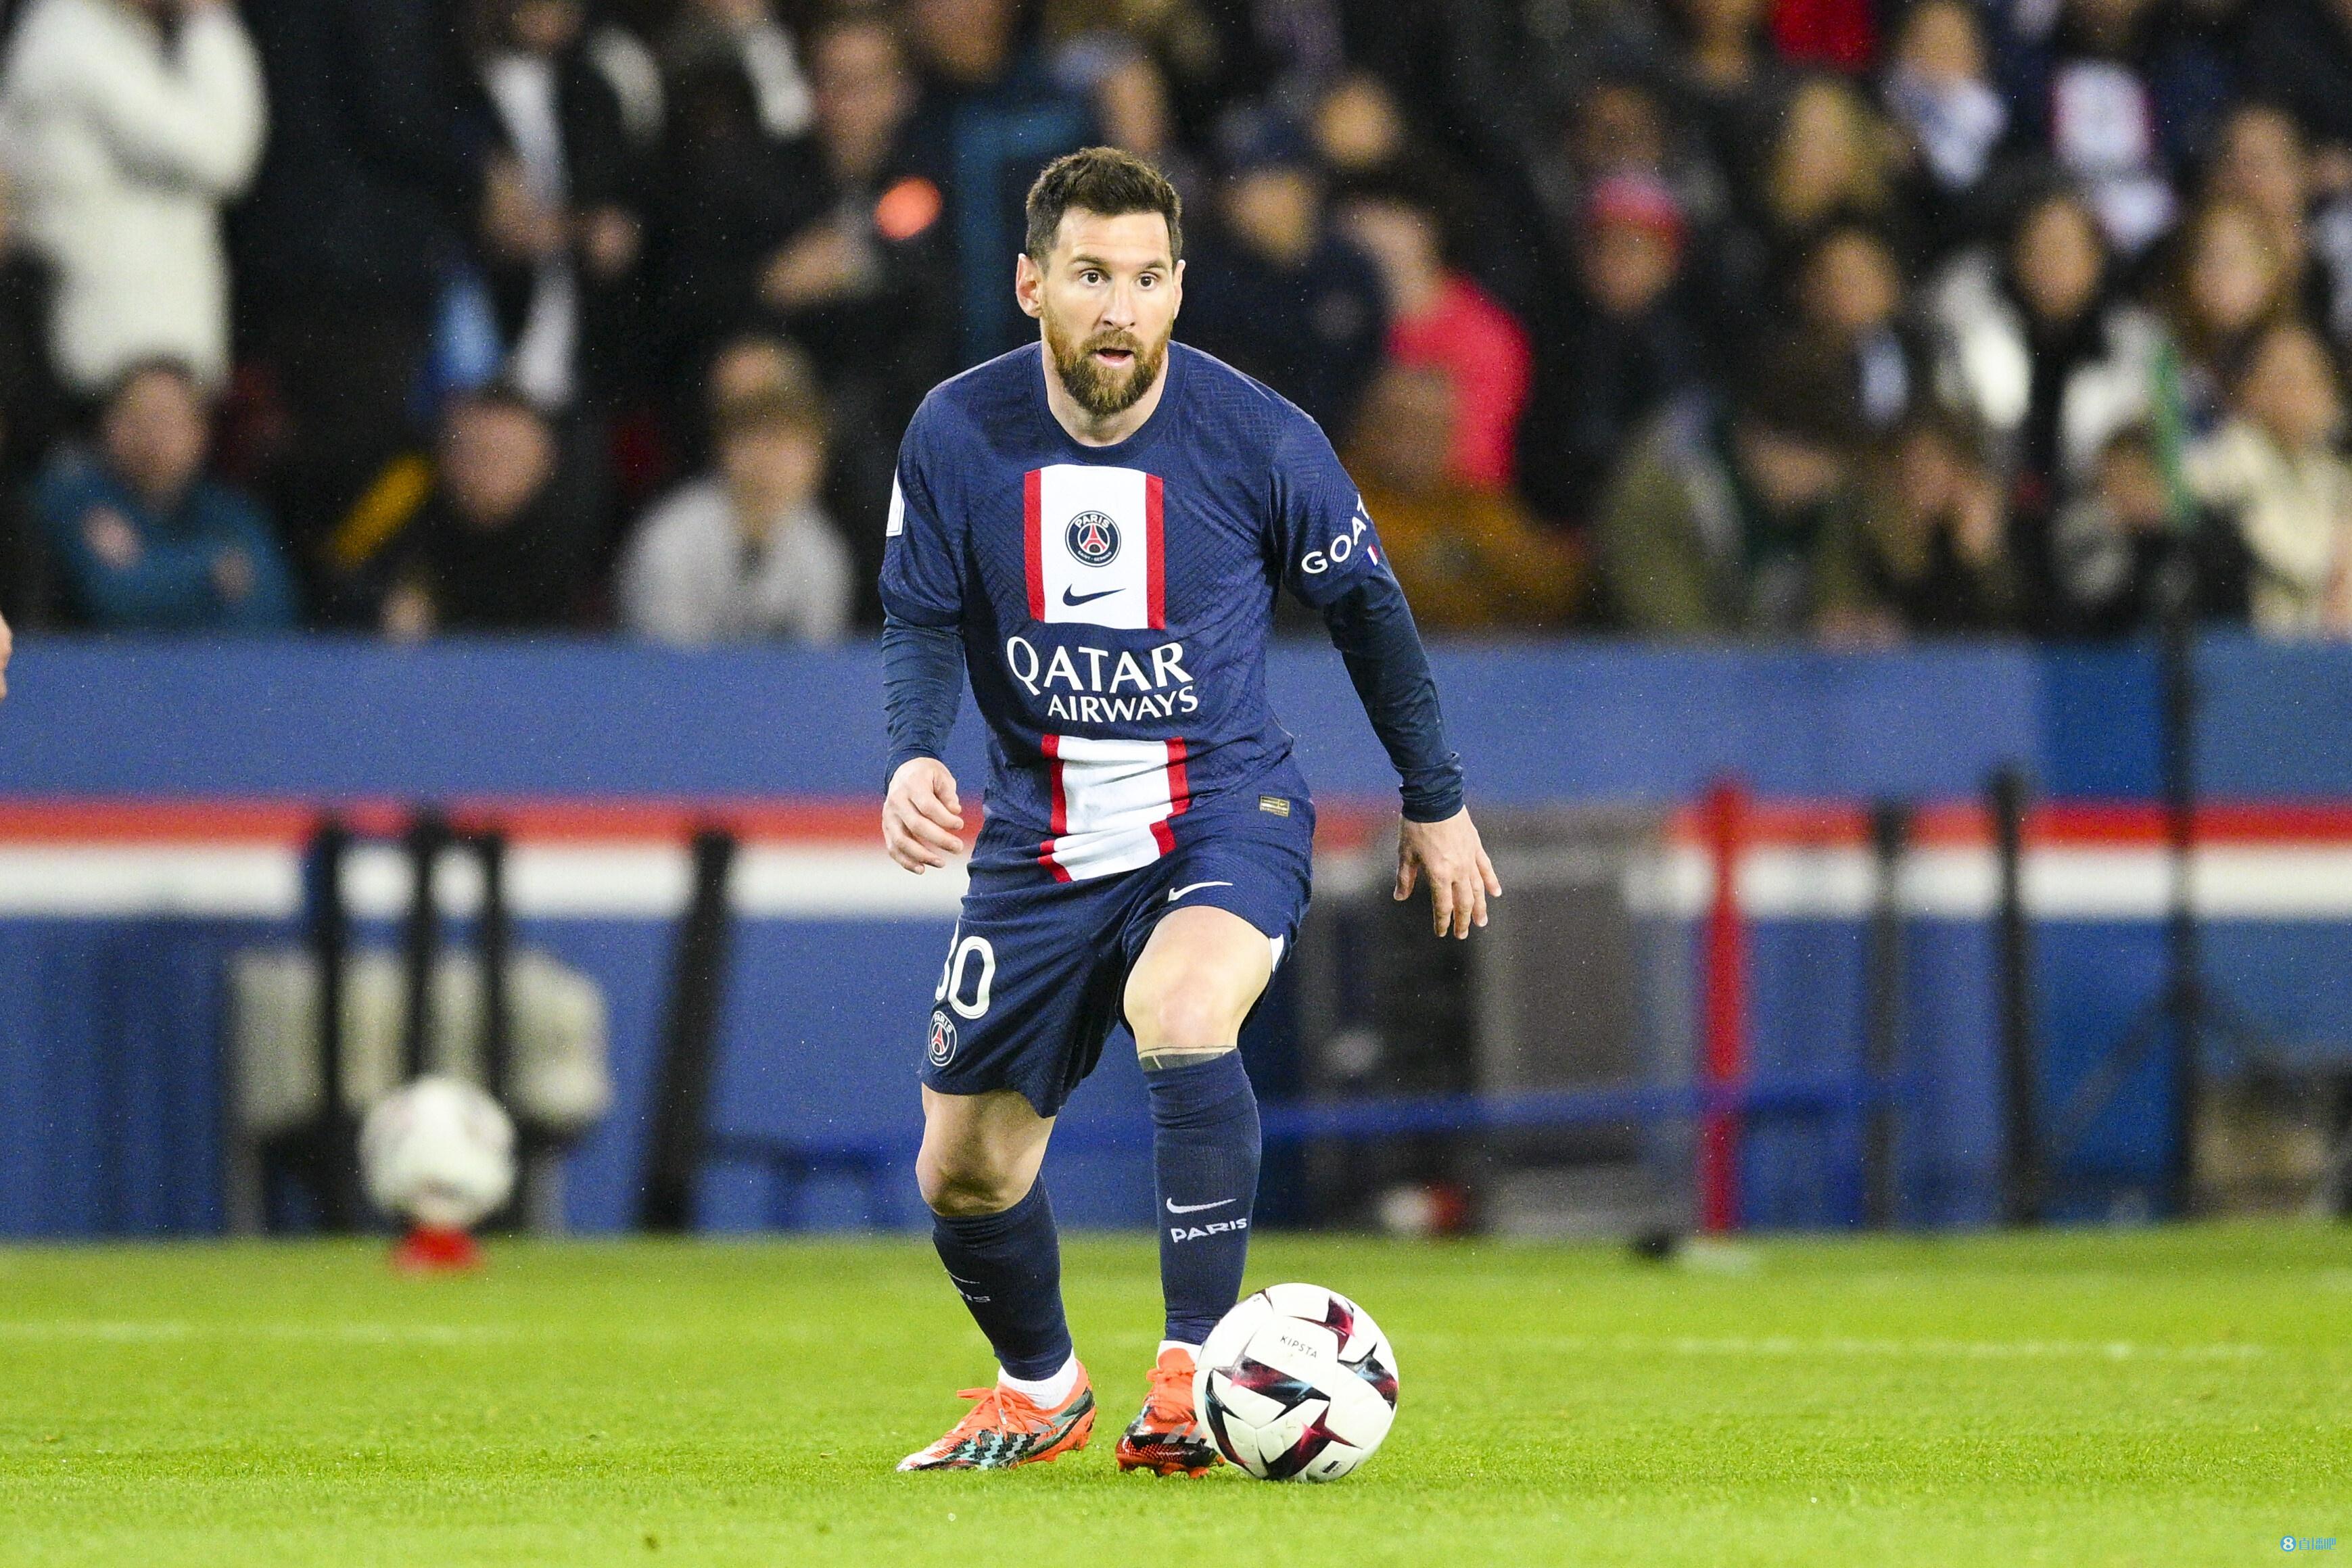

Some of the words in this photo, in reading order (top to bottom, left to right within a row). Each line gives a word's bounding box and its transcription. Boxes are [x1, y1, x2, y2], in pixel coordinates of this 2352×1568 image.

[1074, 515, 1110, 528] PARIS
[1006, 636, 1194, 696] QATAR
[1048, 686, 1198, 723] AIRWAYS
[1171, 1218, 1247, 1243] PARIS
[1279, 1335, 1317, 1358] KIPSTA
